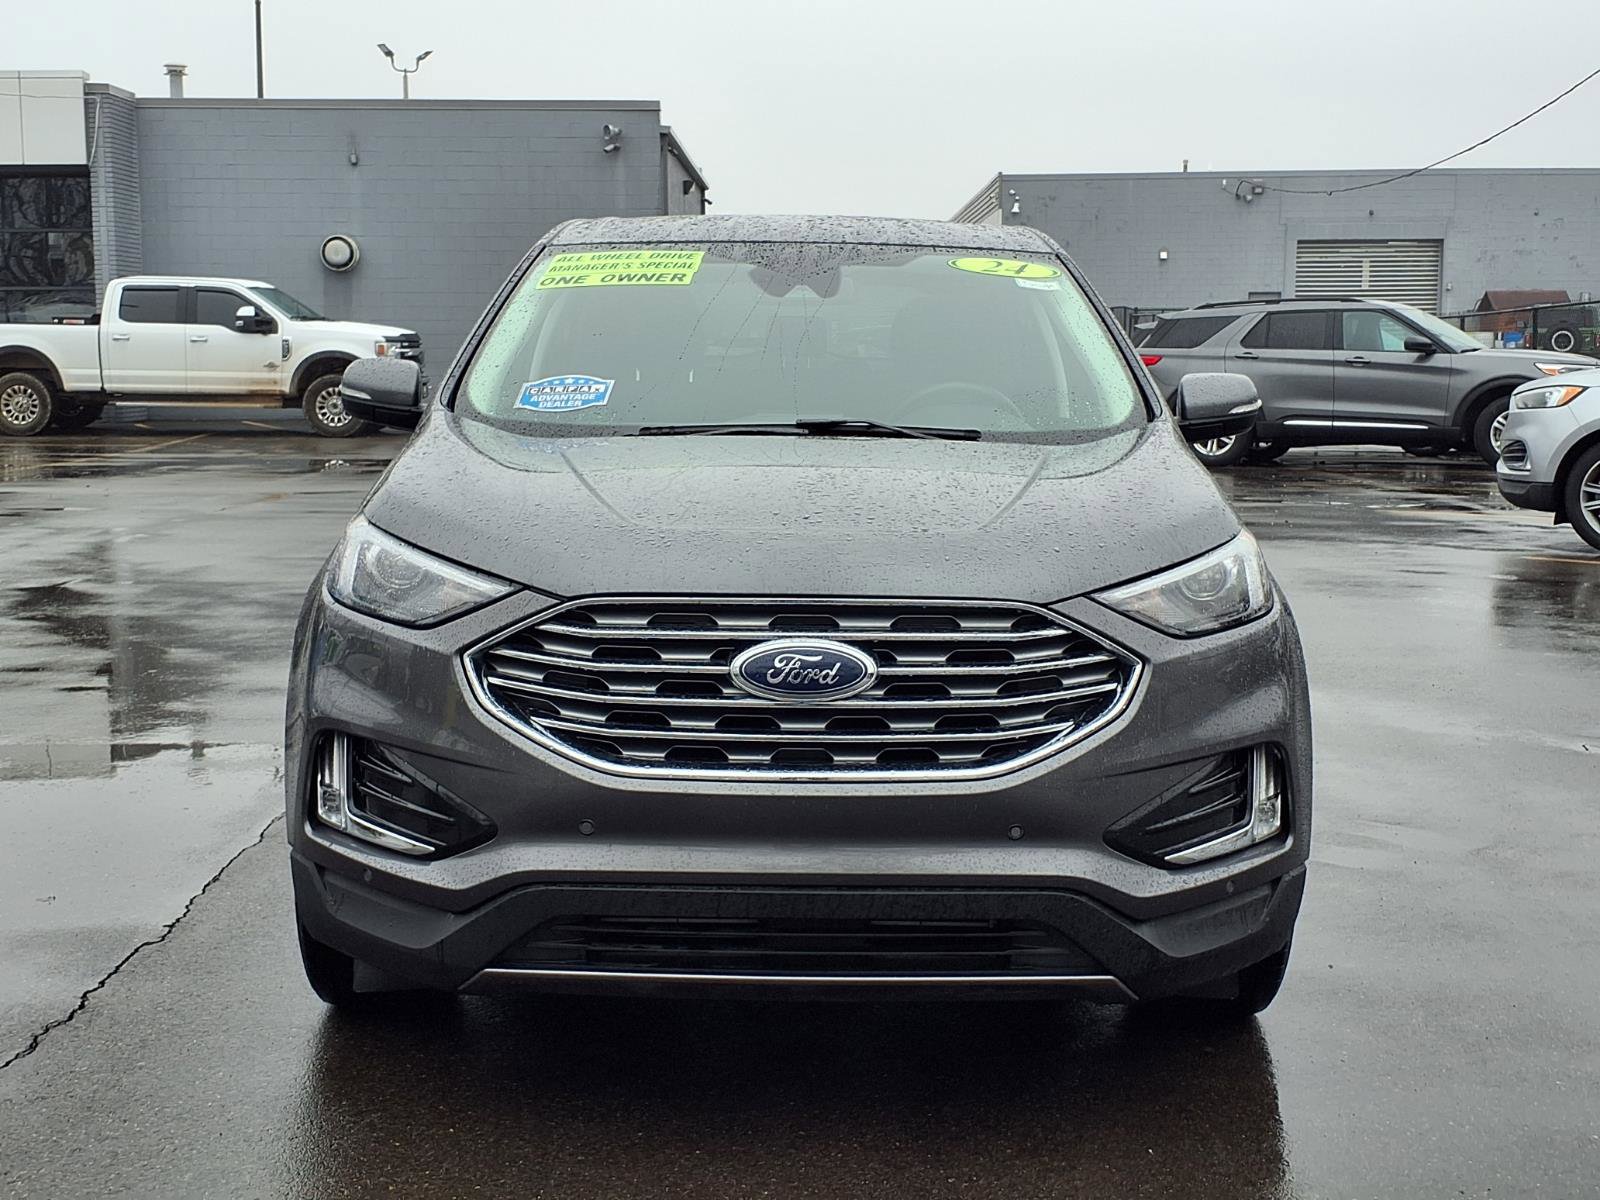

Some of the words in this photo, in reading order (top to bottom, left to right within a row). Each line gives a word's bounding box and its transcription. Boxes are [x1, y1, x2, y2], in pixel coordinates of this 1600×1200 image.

[555, 255, 584, 263] ALL
[590, 253, 642, 261] WHEEL
[648, 252, 697, 260] DRIVE
[549, 262, 633, 273] MANAGER'S
[636, 261, 696, 270] SPECIAL
[981, 260, 1028, 275] 24
[539, 274, 591, 287] ONE
[600, 272, 687, 283] OWNER
[530, 393, 597, 402] ADVANTAGE
[538, 400, 583, 408] DEALER
[766, 653, 841, 685] Ford
